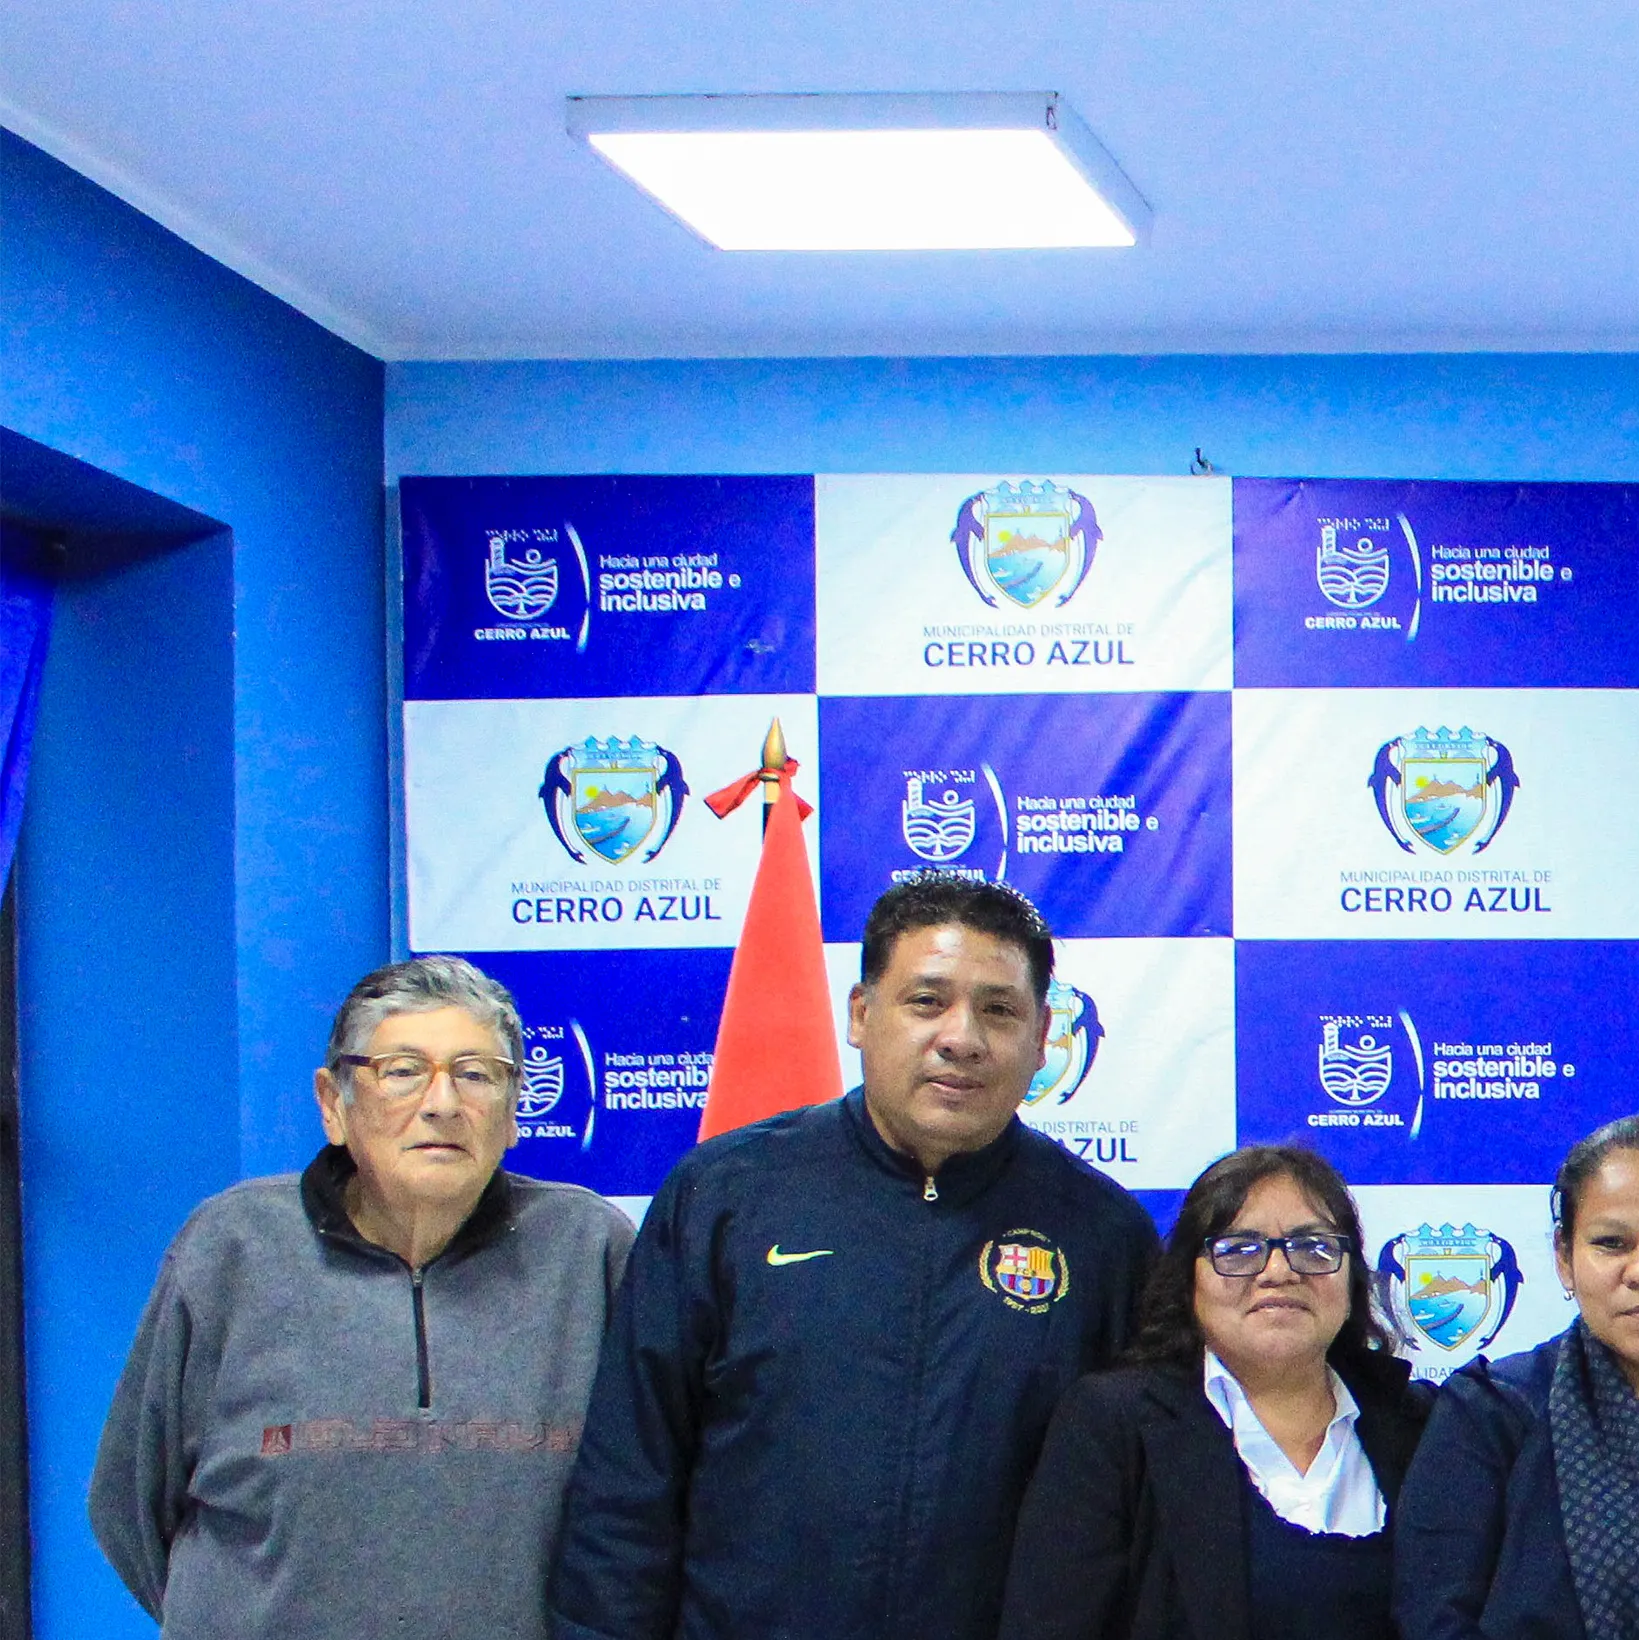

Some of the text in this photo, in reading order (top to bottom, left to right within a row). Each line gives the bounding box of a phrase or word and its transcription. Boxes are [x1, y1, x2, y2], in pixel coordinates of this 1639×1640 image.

[1432, 545, 1549, 561] Hacia una ciudad
[600, 566, 741, 592] sostenible e
[1431, 559, 1572, 583] sostenible e
[601, 589, 705, 611] inclusiva
[1432, 580, 1536, 602] inclusiva
[923, 623, 1132, 637] MUNICIPALIDAD DISTRITAL DE
[1305, 615, 1401, 629] CERRO AZUL
[474, 625, 526, 640] CERRO
[531, 625, 570, 639] AZUL
[924, 640, 1133, 666] CERRO AZUL
[1018, 795, 1135, 812] Hacia una ciudad
[1017, 810, 1158, 833] sostenible e
[1017, 829, 1123, 853] inclusiva
[1341, 870, 1551, 882] MUNICIPALIDAD DISTRITAL DE
[511, 878, 719, 894] MUNICIPALIDAD DISTRITAL DE
[1341, 887, 1550, 911] CERRO AZUL
[512, 896, 720, 923] CERRO AZUL
[605, 1053, 674, 1066] Hacia una
[1434, 1042, 1551, 1058] Hacia una ciudad
[1434, 1055, 1575, 1080] sostenible e
[1434, 1077, 1539, 1099] inclusiva
[1043, 1121, 1138, 1133] DISTRITAL DE
[1308, 1112, 1404, 1126] CERRO AZUL
